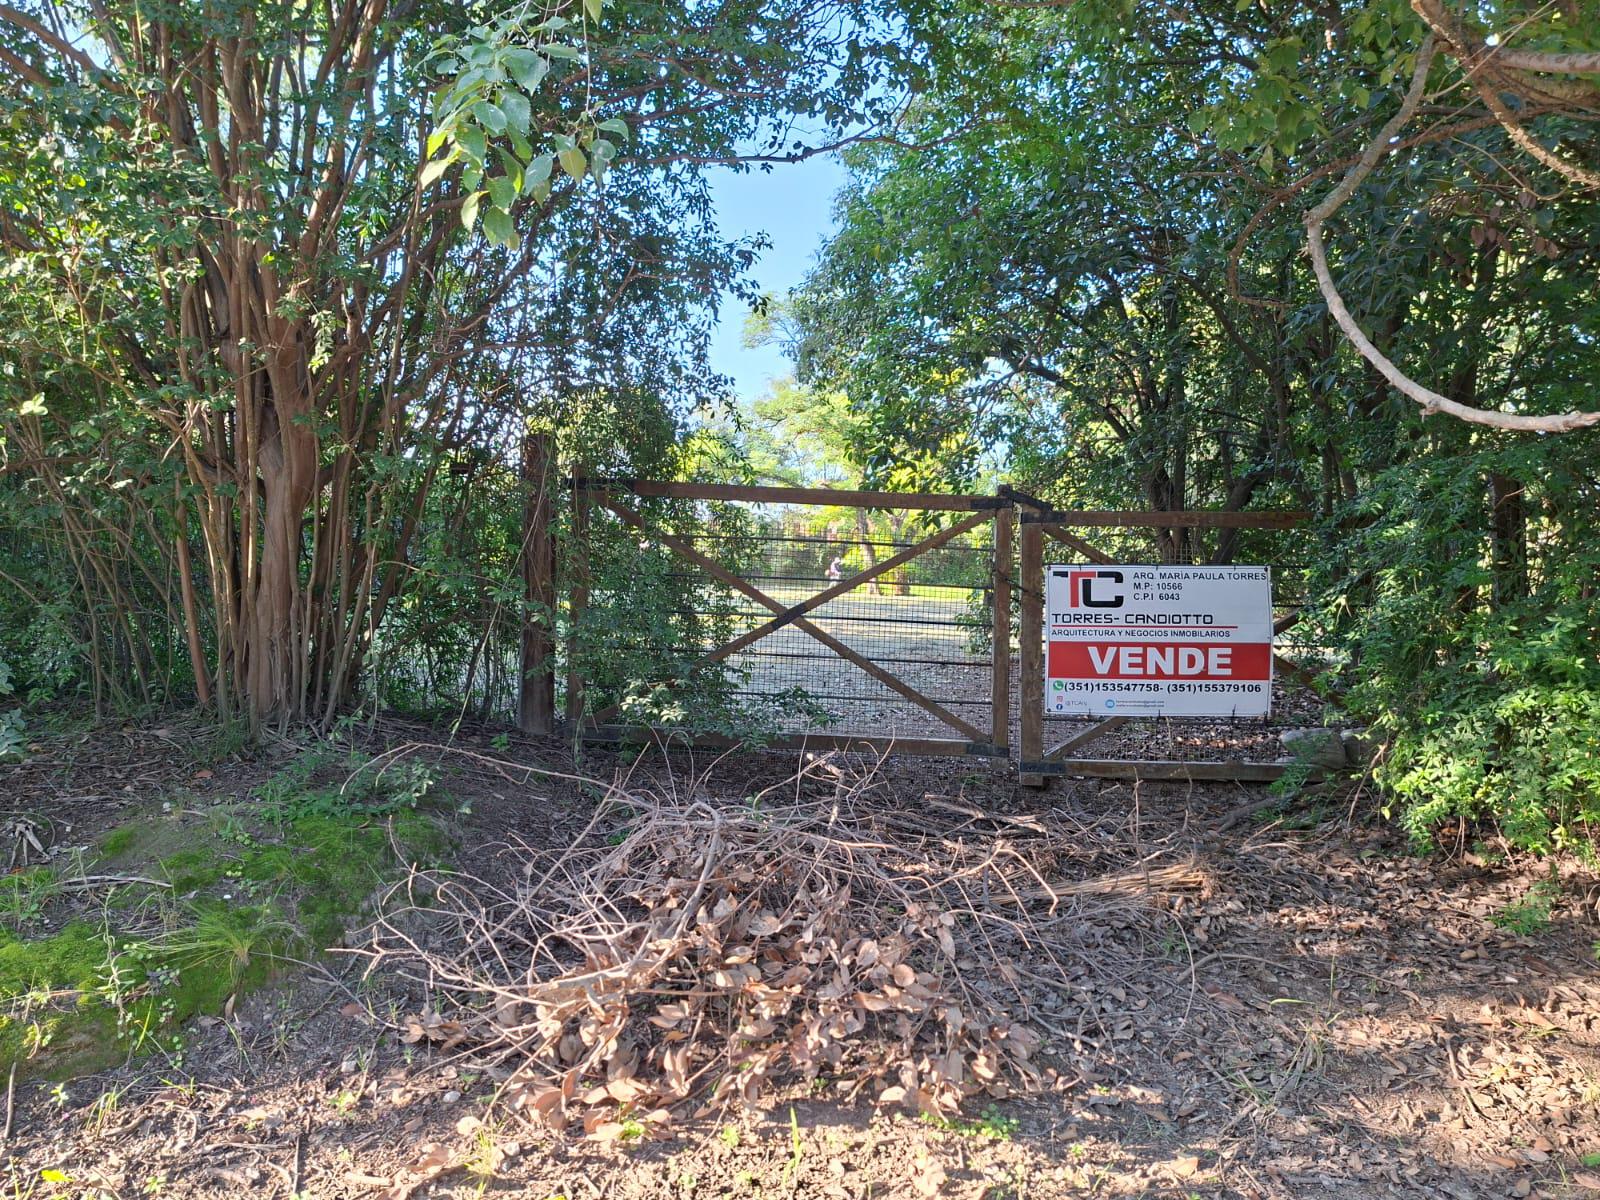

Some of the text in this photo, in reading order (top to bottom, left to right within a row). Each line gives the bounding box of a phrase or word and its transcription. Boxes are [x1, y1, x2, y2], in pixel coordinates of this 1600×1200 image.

[1227, 573, 1267, 581] TORRES
[1053, 571, 1124, 608] TC
[1158, 593, 1181, 601] 6043
[1051, 613, 1213, 625] TORRES- CANDIOTTO
[1051, 629, 1116, 637] ARQUITECTURA
[1087, 646, 1233, 676] VENDE
[1064, 682, 1262, 694] (351)153547758- (351)155379106
